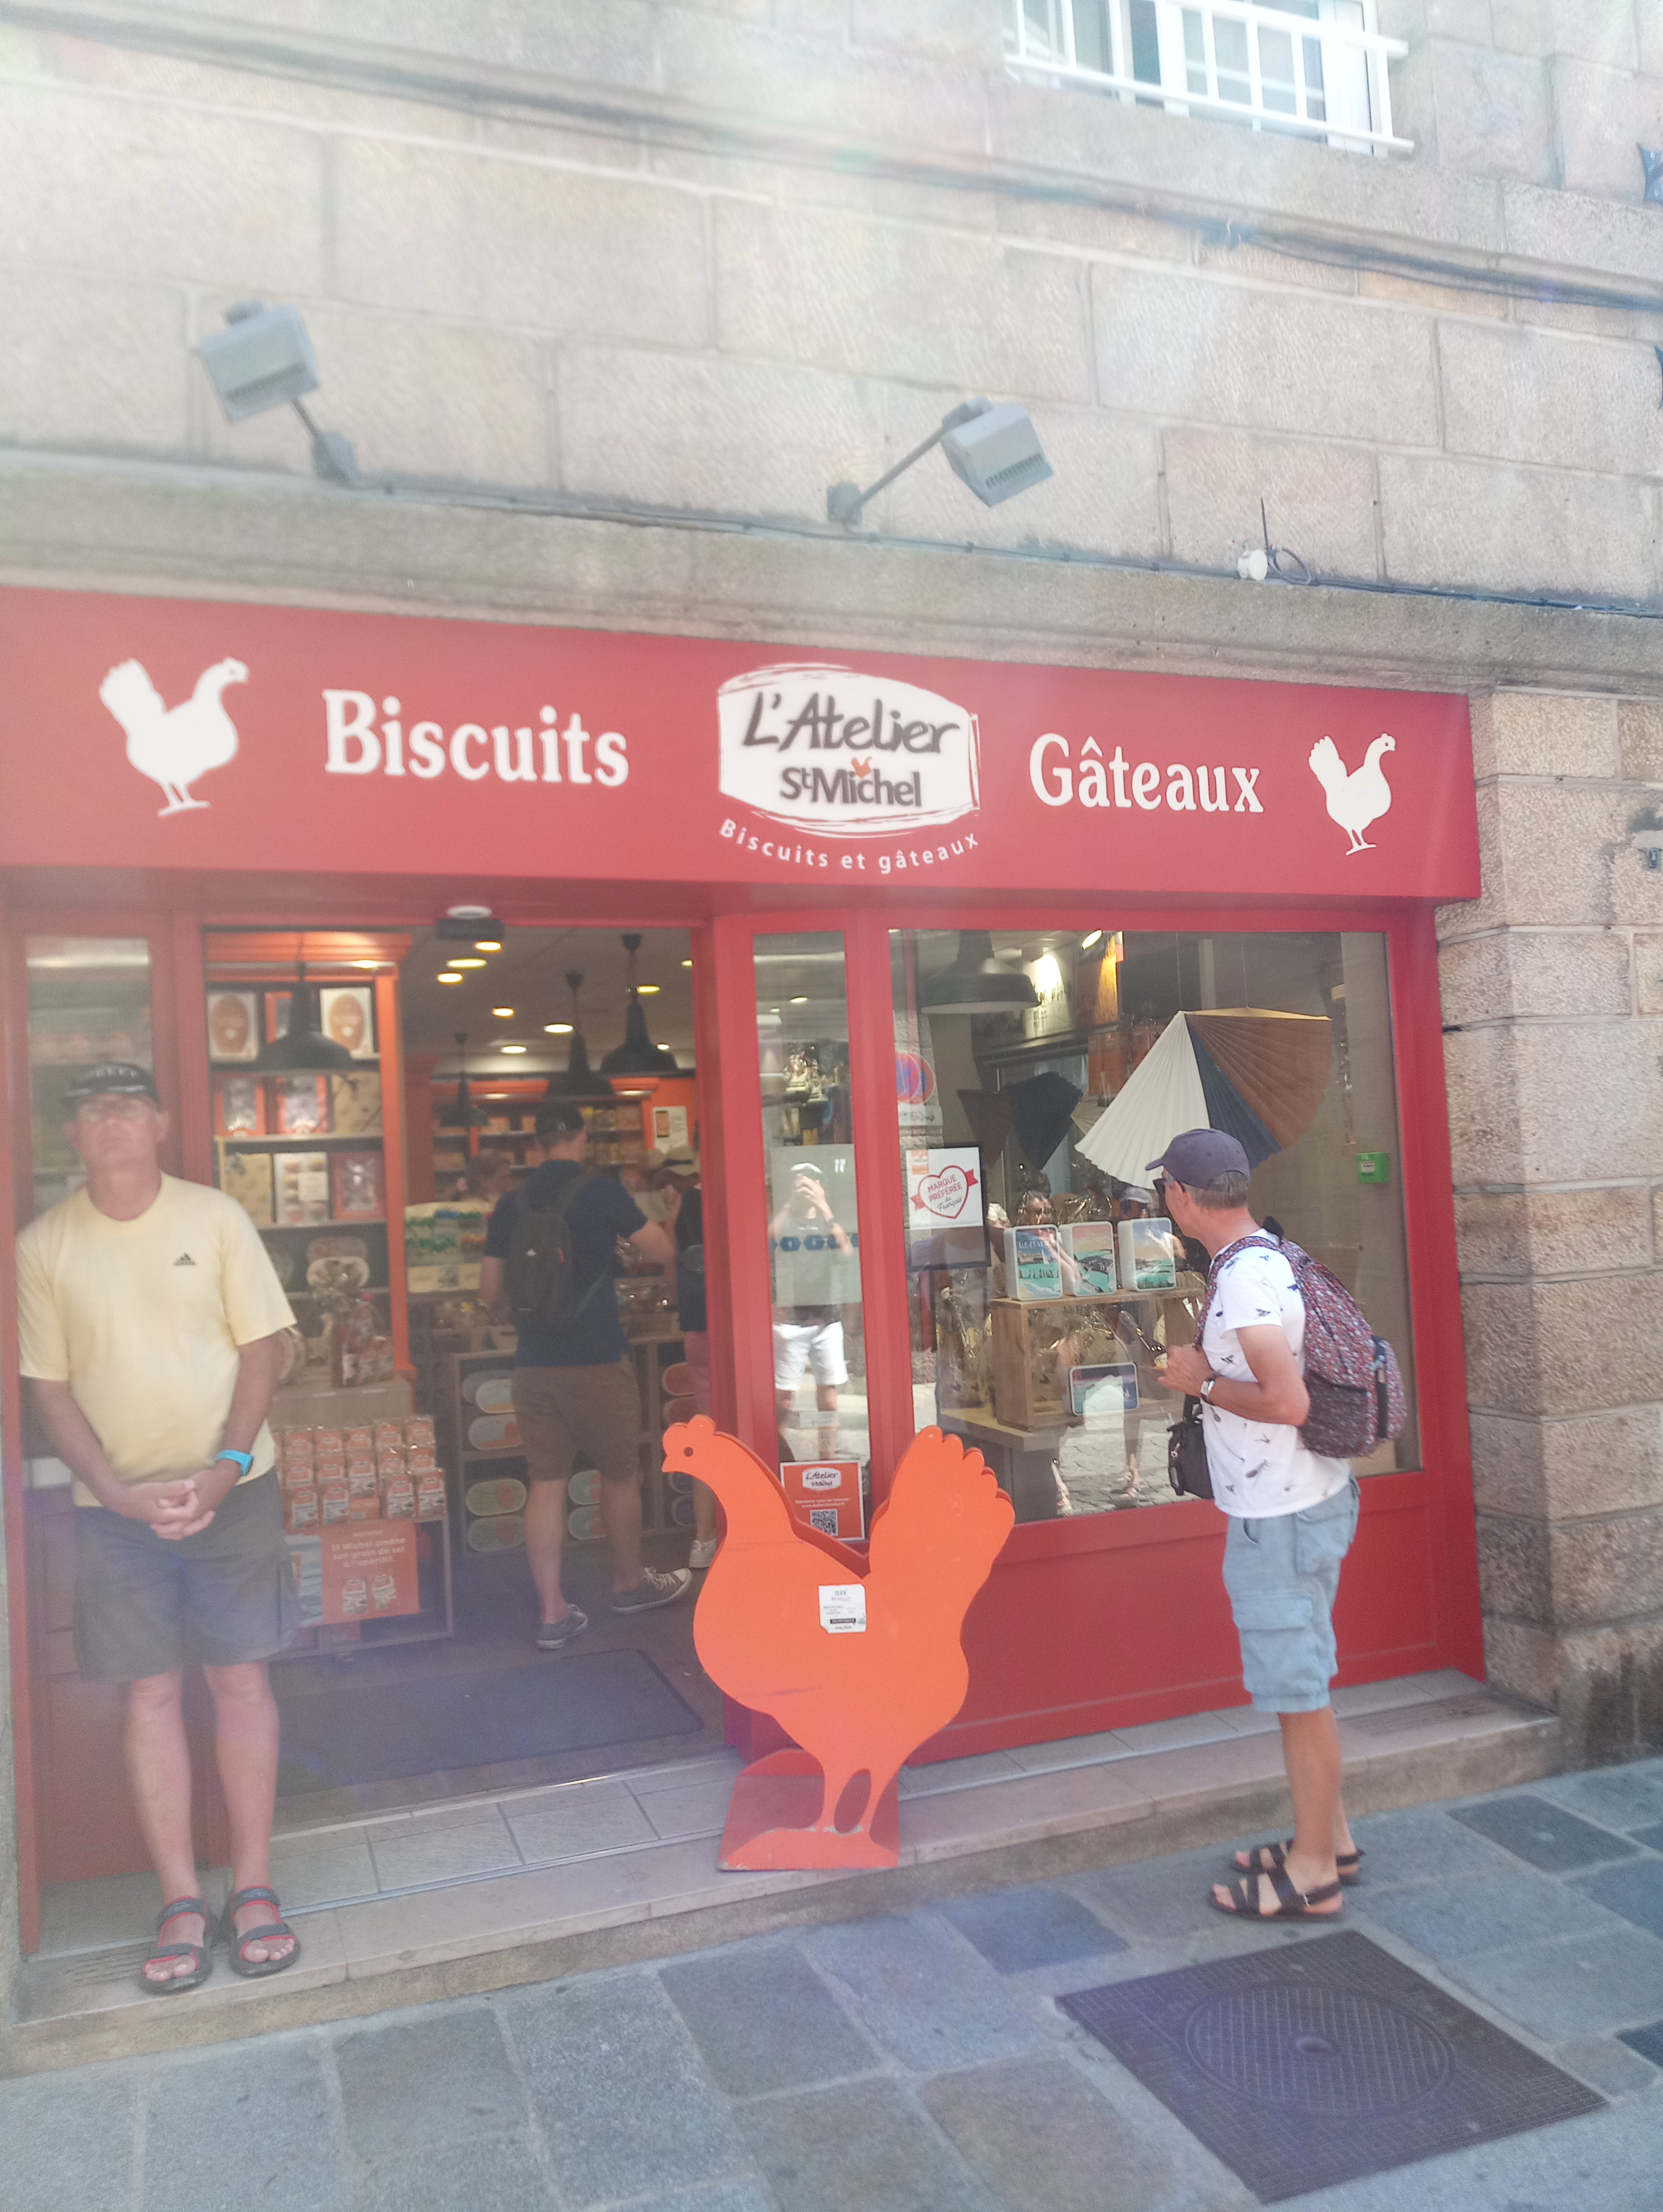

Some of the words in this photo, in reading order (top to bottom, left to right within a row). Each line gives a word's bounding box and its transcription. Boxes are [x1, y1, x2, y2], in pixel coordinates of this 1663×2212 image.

[322, 689, 629, 787] Biscuits
[742, 692, 960, 754] L'Atelier
[1029, 733, 1264, 812] Gâteaux
[719, 819, 829, 867] Biscuits
[842, 853, 865, 870] et
[879, 833, 979, 874] gâteaux
[928, 1174, 957, 1193] MARQUE
[929, 1182, 963, 1202] PRÉFÉRÉE
[805, 1471, 838, 1480] L'Atelier
